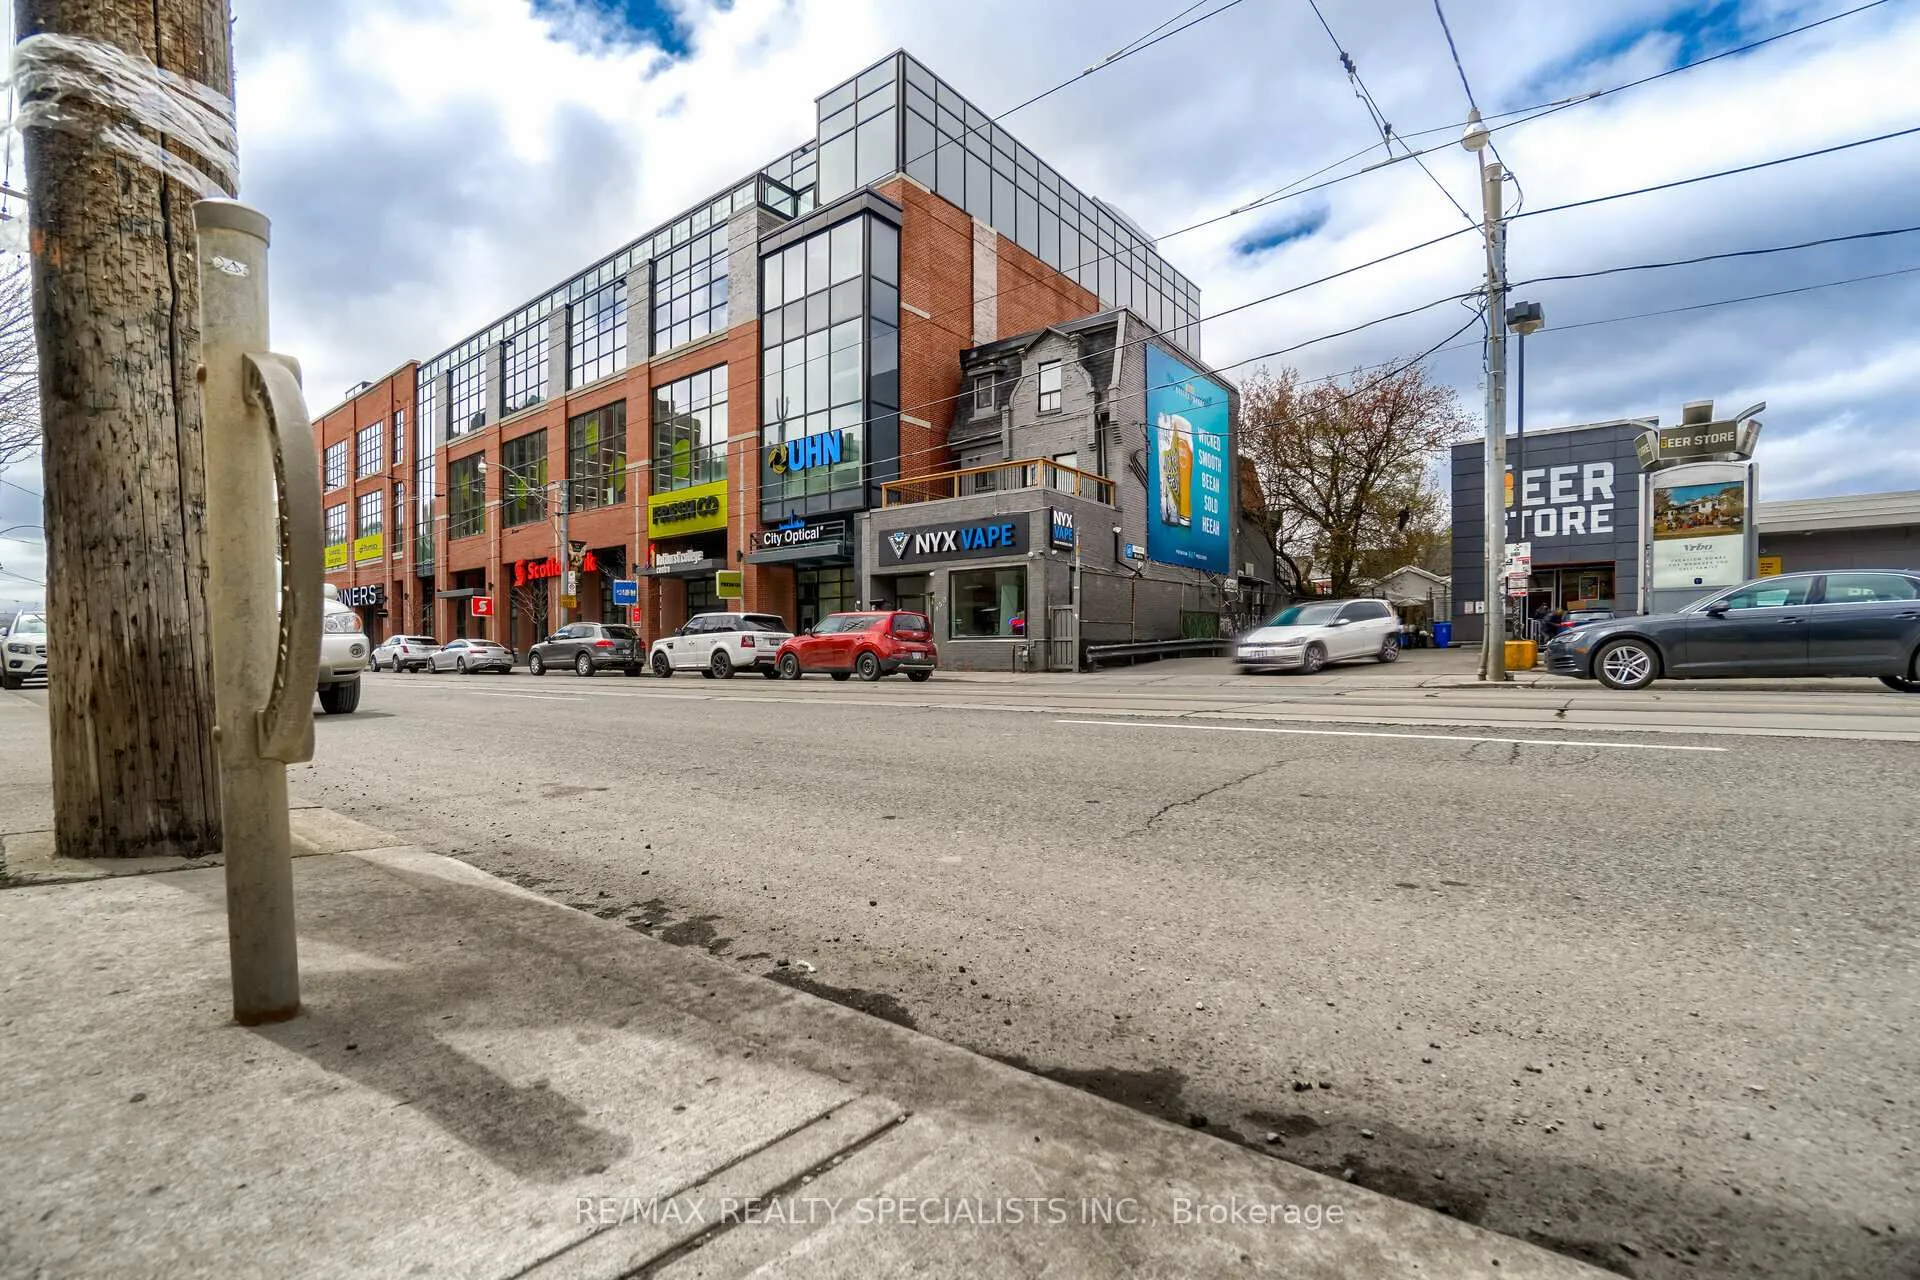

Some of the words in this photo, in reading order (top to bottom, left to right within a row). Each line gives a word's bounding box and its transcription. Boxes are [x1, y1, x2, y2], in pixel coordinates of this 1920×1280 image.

[788, 429, 842, 472] UHN
[1660, 436, 1691, 449] BEER
[1694, 431, 1735, 446] STORE
[1198, 449, 1222, 472] SMOOTH
[1053, 510, 1073, 528] NYX
[1504, 503, 1614, 539] TORE
[763, 532, 782, 546] City
[784, 526, 820, 544] Optical
[915, 530, 958, 555] NYX
[961, 523, 1014, 550] VAPE
[1053, 525, 1073, 541] VAPE
